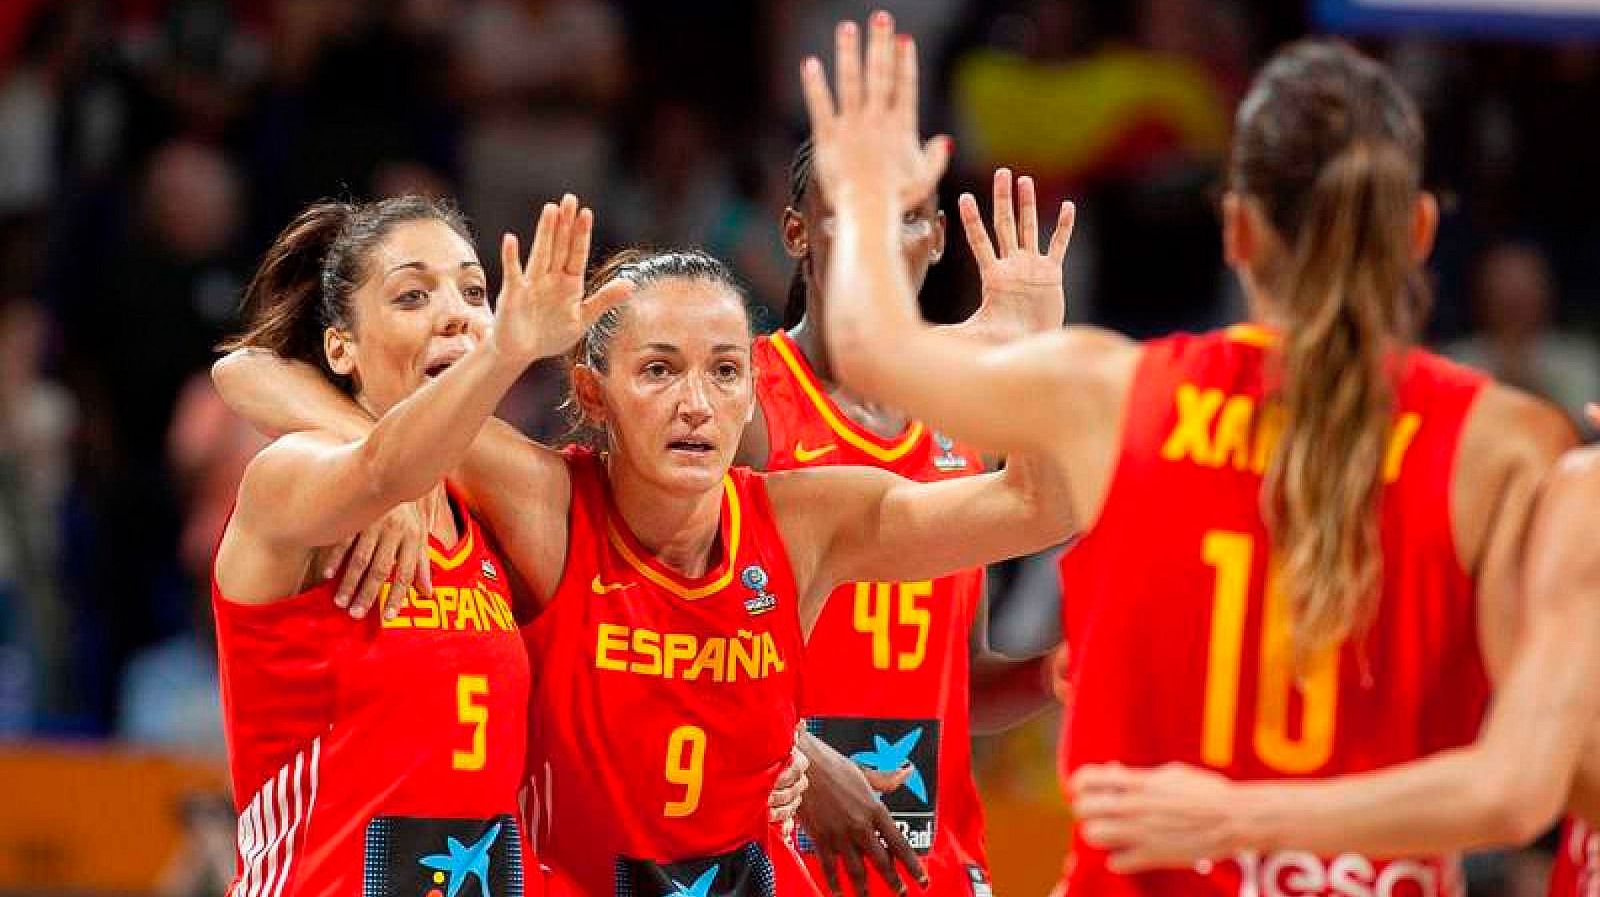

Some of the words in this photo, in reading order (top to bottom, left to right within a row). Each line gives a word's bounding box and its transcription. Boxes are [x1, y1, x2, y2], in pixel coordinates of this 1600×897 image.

[596, 623, 785, 683] ESPAÑA
[854, 581, 932, 670] 45
[453, 674, 489, 771] 5
[664, 724, 707, 817] 9
